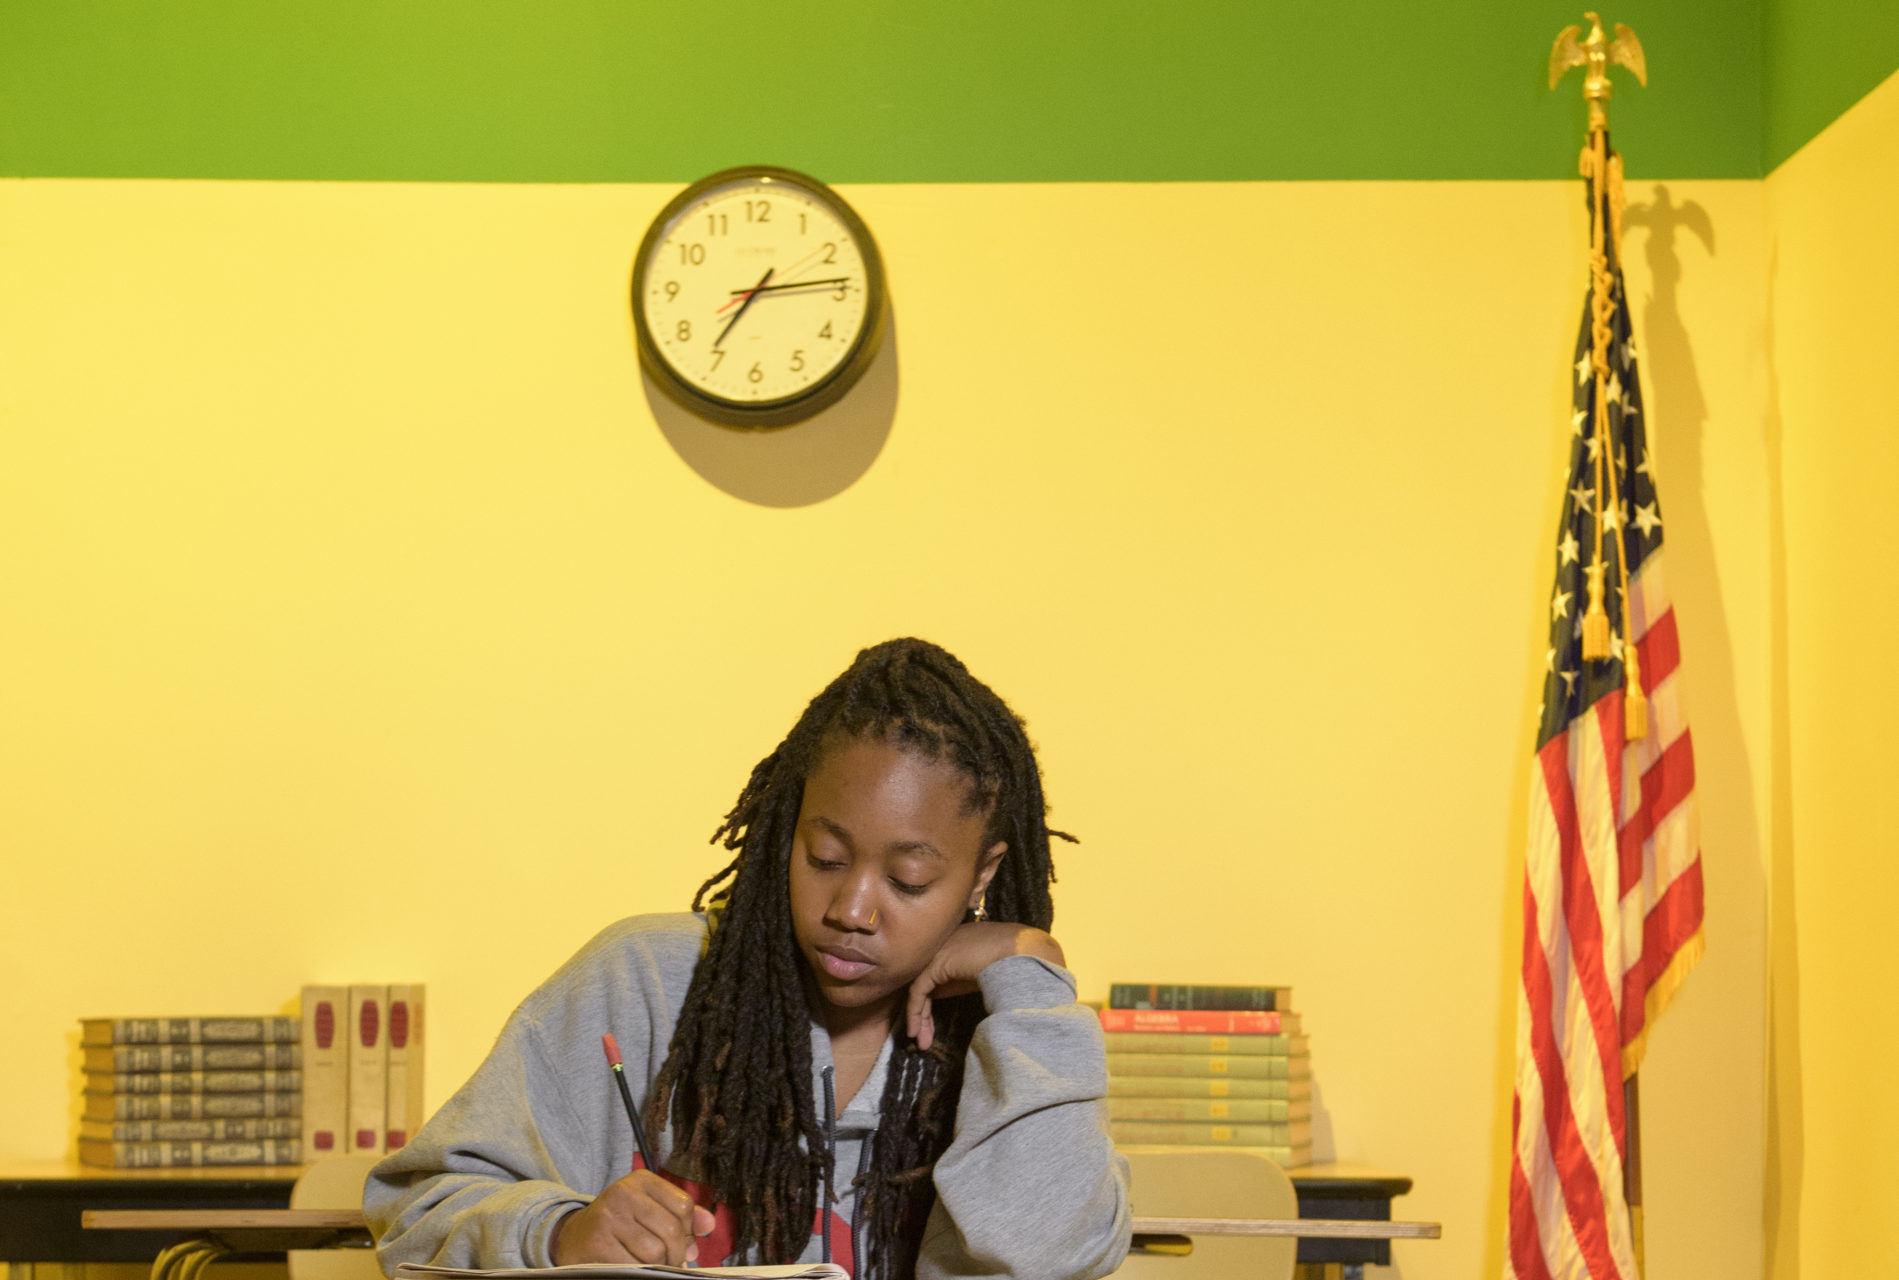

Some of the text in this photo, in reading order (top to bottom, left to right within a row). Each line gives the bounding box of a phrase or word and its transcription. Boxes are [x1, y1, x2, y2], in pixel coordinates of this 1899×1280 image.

[745, 200, 771, 223] 12
[706, 213, 728, 236] 11
[798, 213, 807, 236] 1
[679, 243, 705, 266] 10
[822, 242, 838, 265] 2
[664, 281, 680, 303] 9
[831, 279, 848, 302] 3
[676, 320, 692, 342] 8
[817, 319, 833, 340] 4
[710, 350, 727, 372] 7
[789, 349, 806, 373] 5
[748, 362, 764, 384] 6
